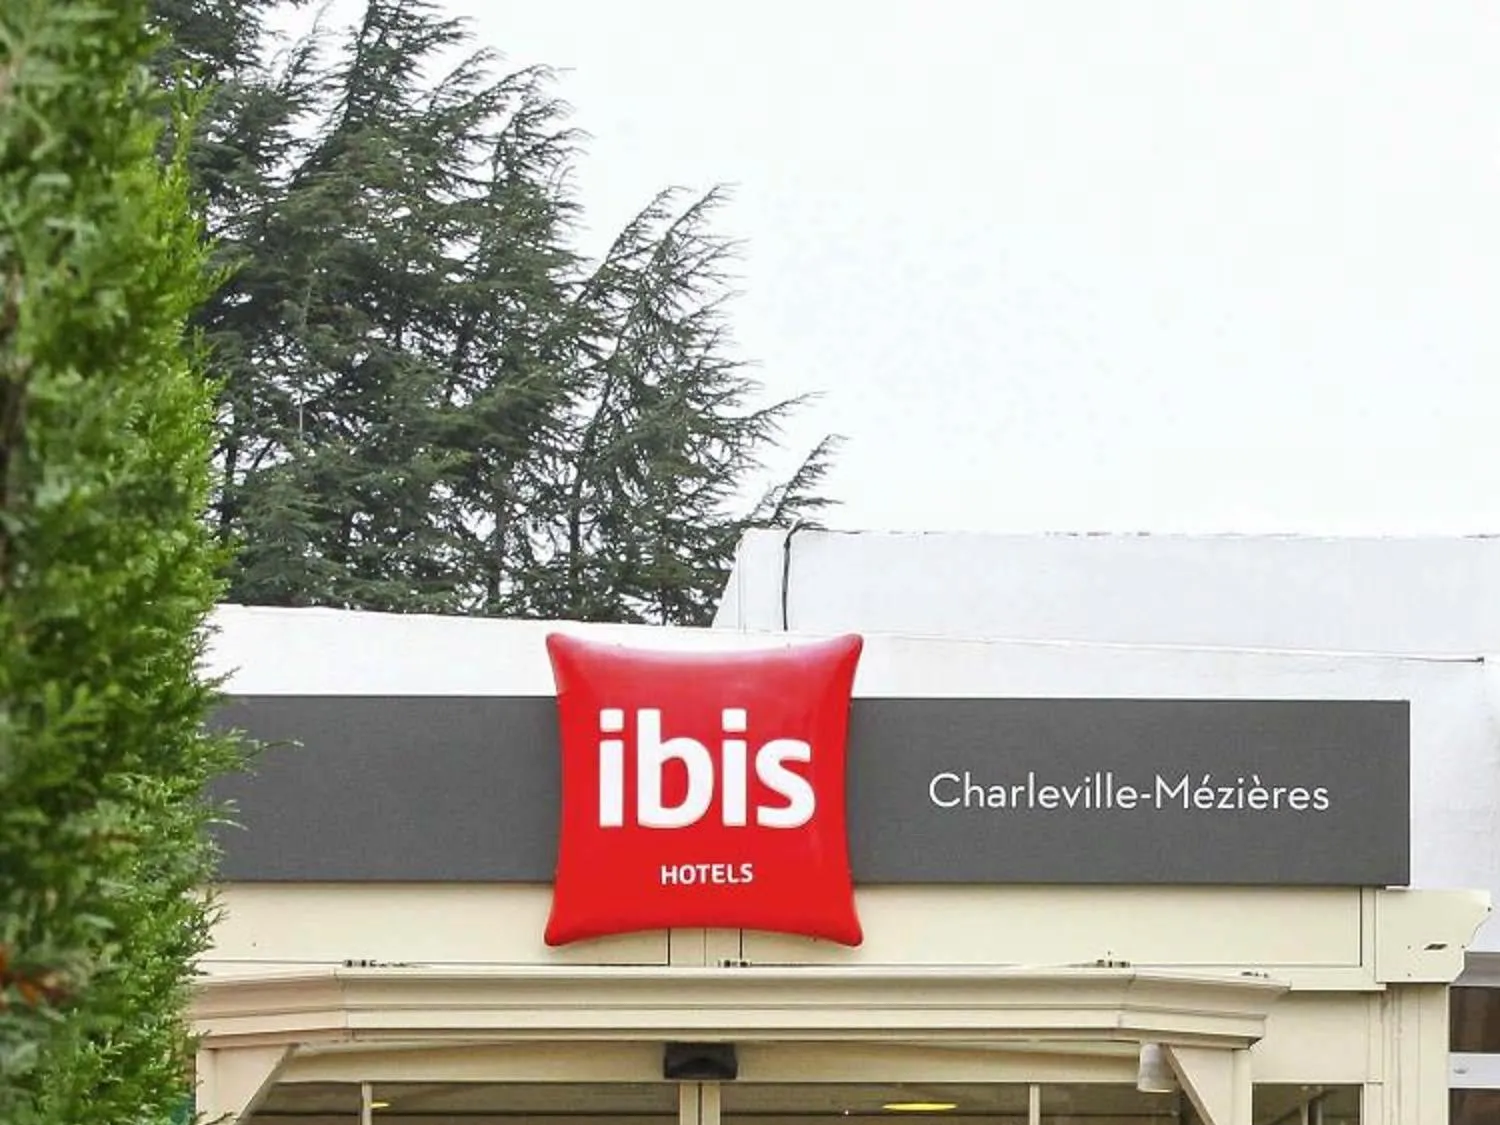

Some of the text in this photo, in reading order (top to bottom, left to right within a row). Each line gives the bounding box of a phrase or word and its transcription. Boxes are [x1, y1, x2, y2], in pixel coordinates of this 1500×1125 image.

[599, 708, 815, 829] ibis
[929, 771, 1329, 809] Charleville-Mézières
[661, 863, 753, 885] HOTELS
